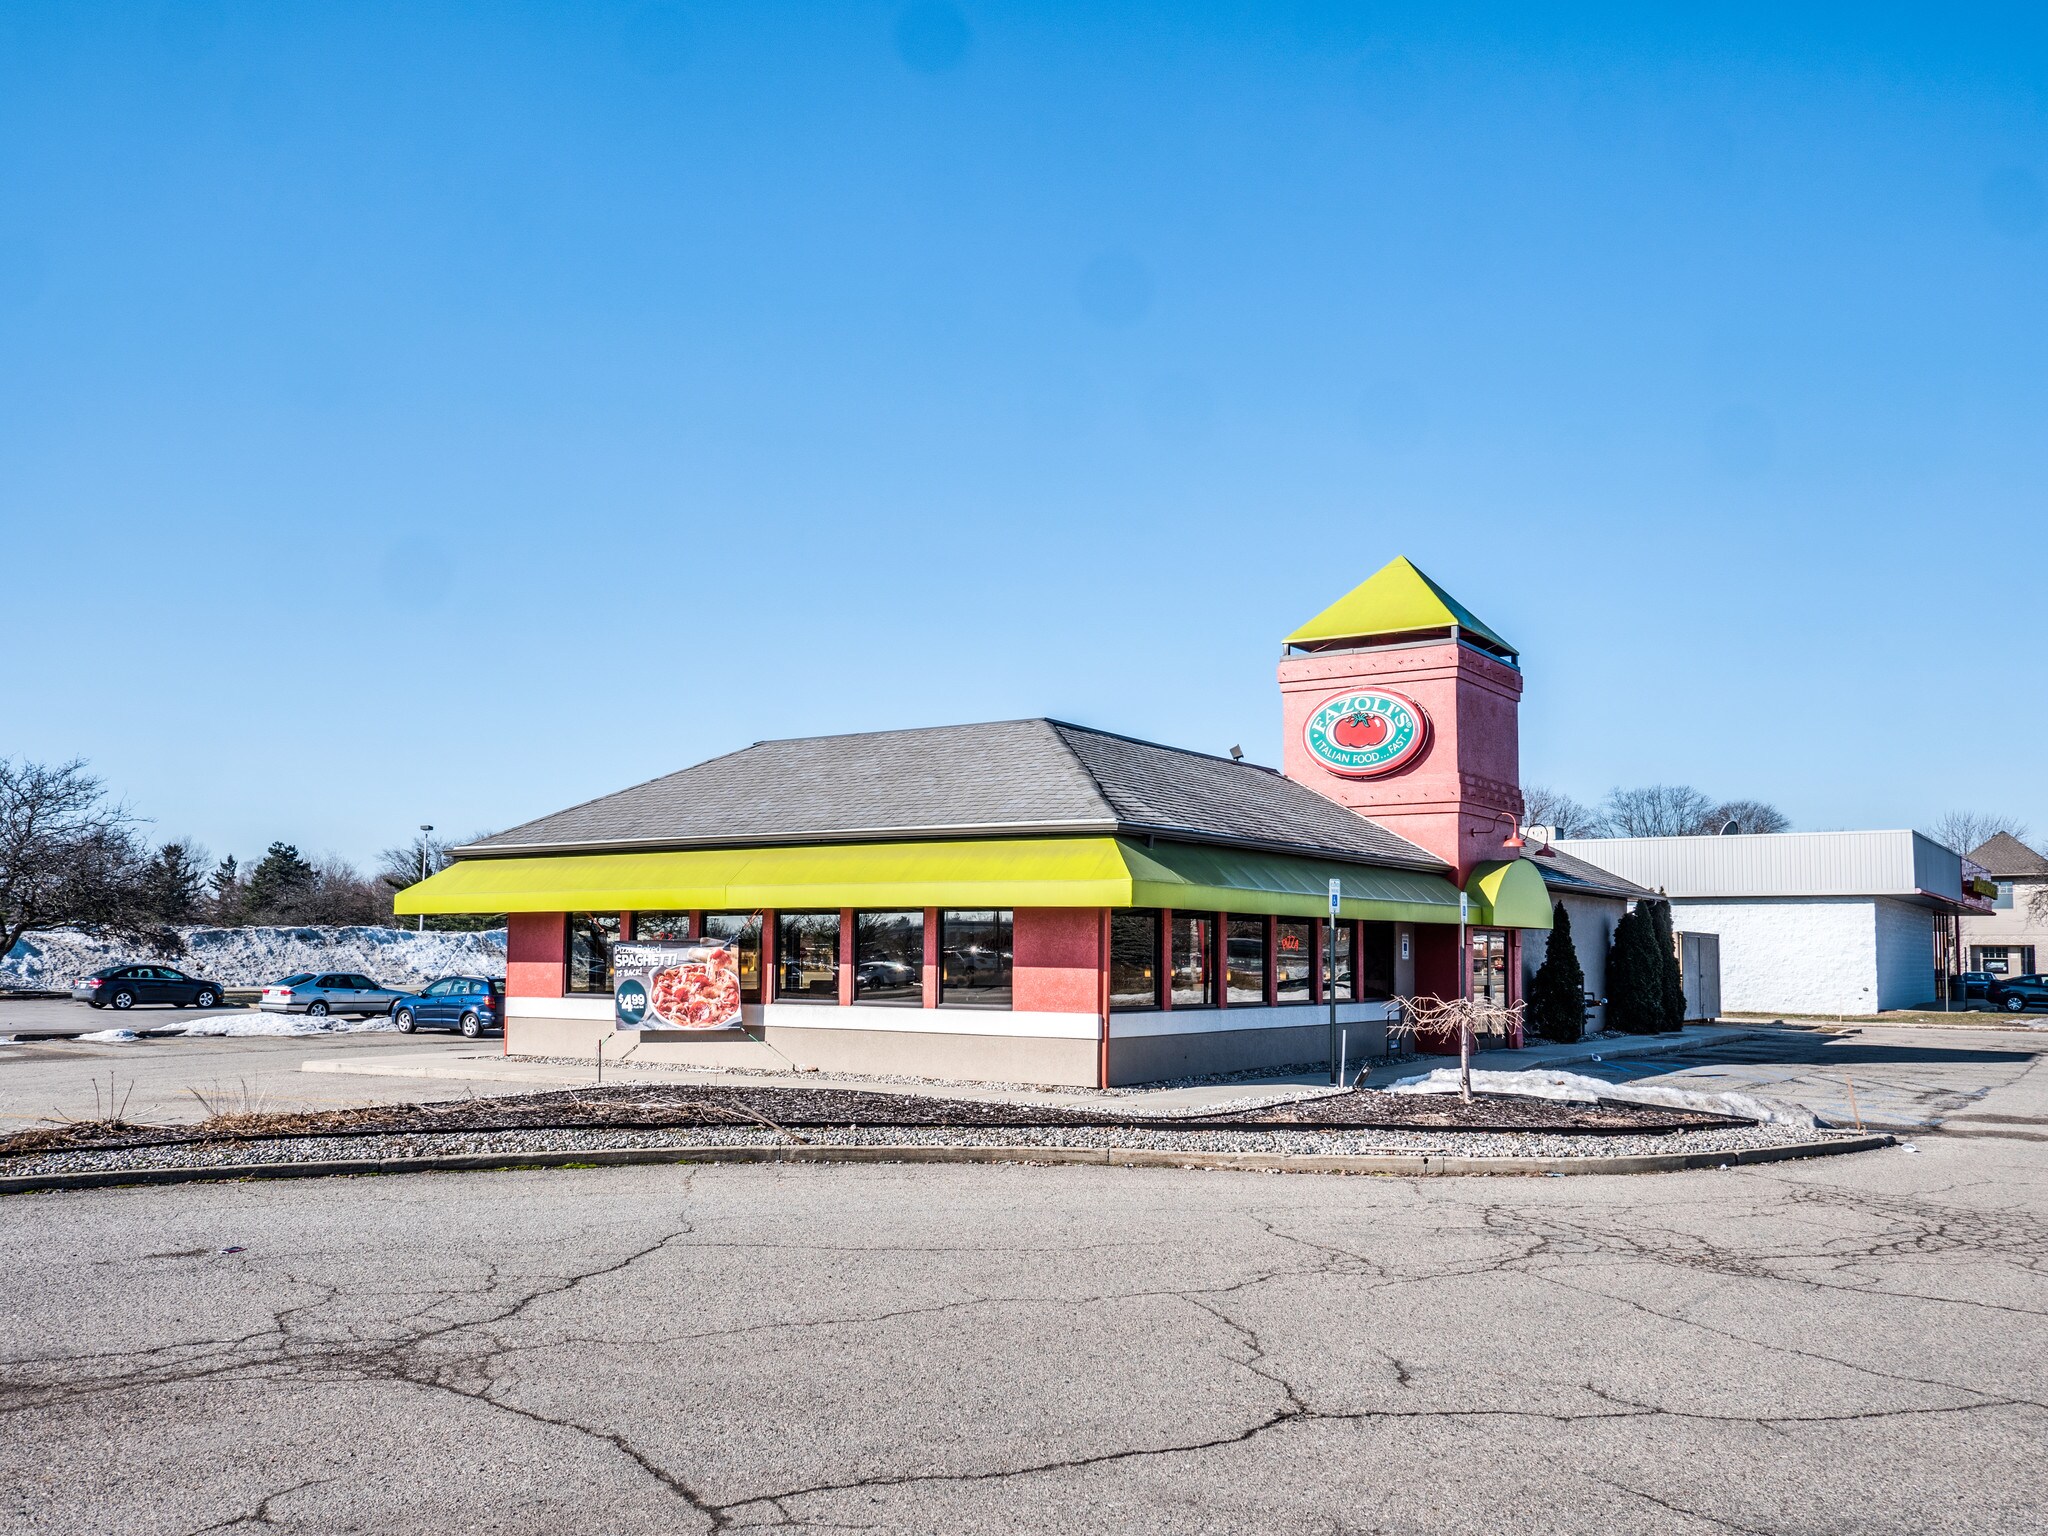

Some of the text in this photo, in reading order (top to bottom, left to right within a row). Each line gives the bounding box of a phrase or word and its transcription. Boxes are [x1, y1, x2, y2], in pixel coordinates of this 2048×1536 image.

[1312, 697, 1409, 734] FAZOLI'S
[1315, 739, 1350, 764] ITALIAN
[1282, 935, 1299, 951] PIZZA
[615, 953, 677, 967] SPAGHETTI
[616, 968, 642, 978] IS BACK!
